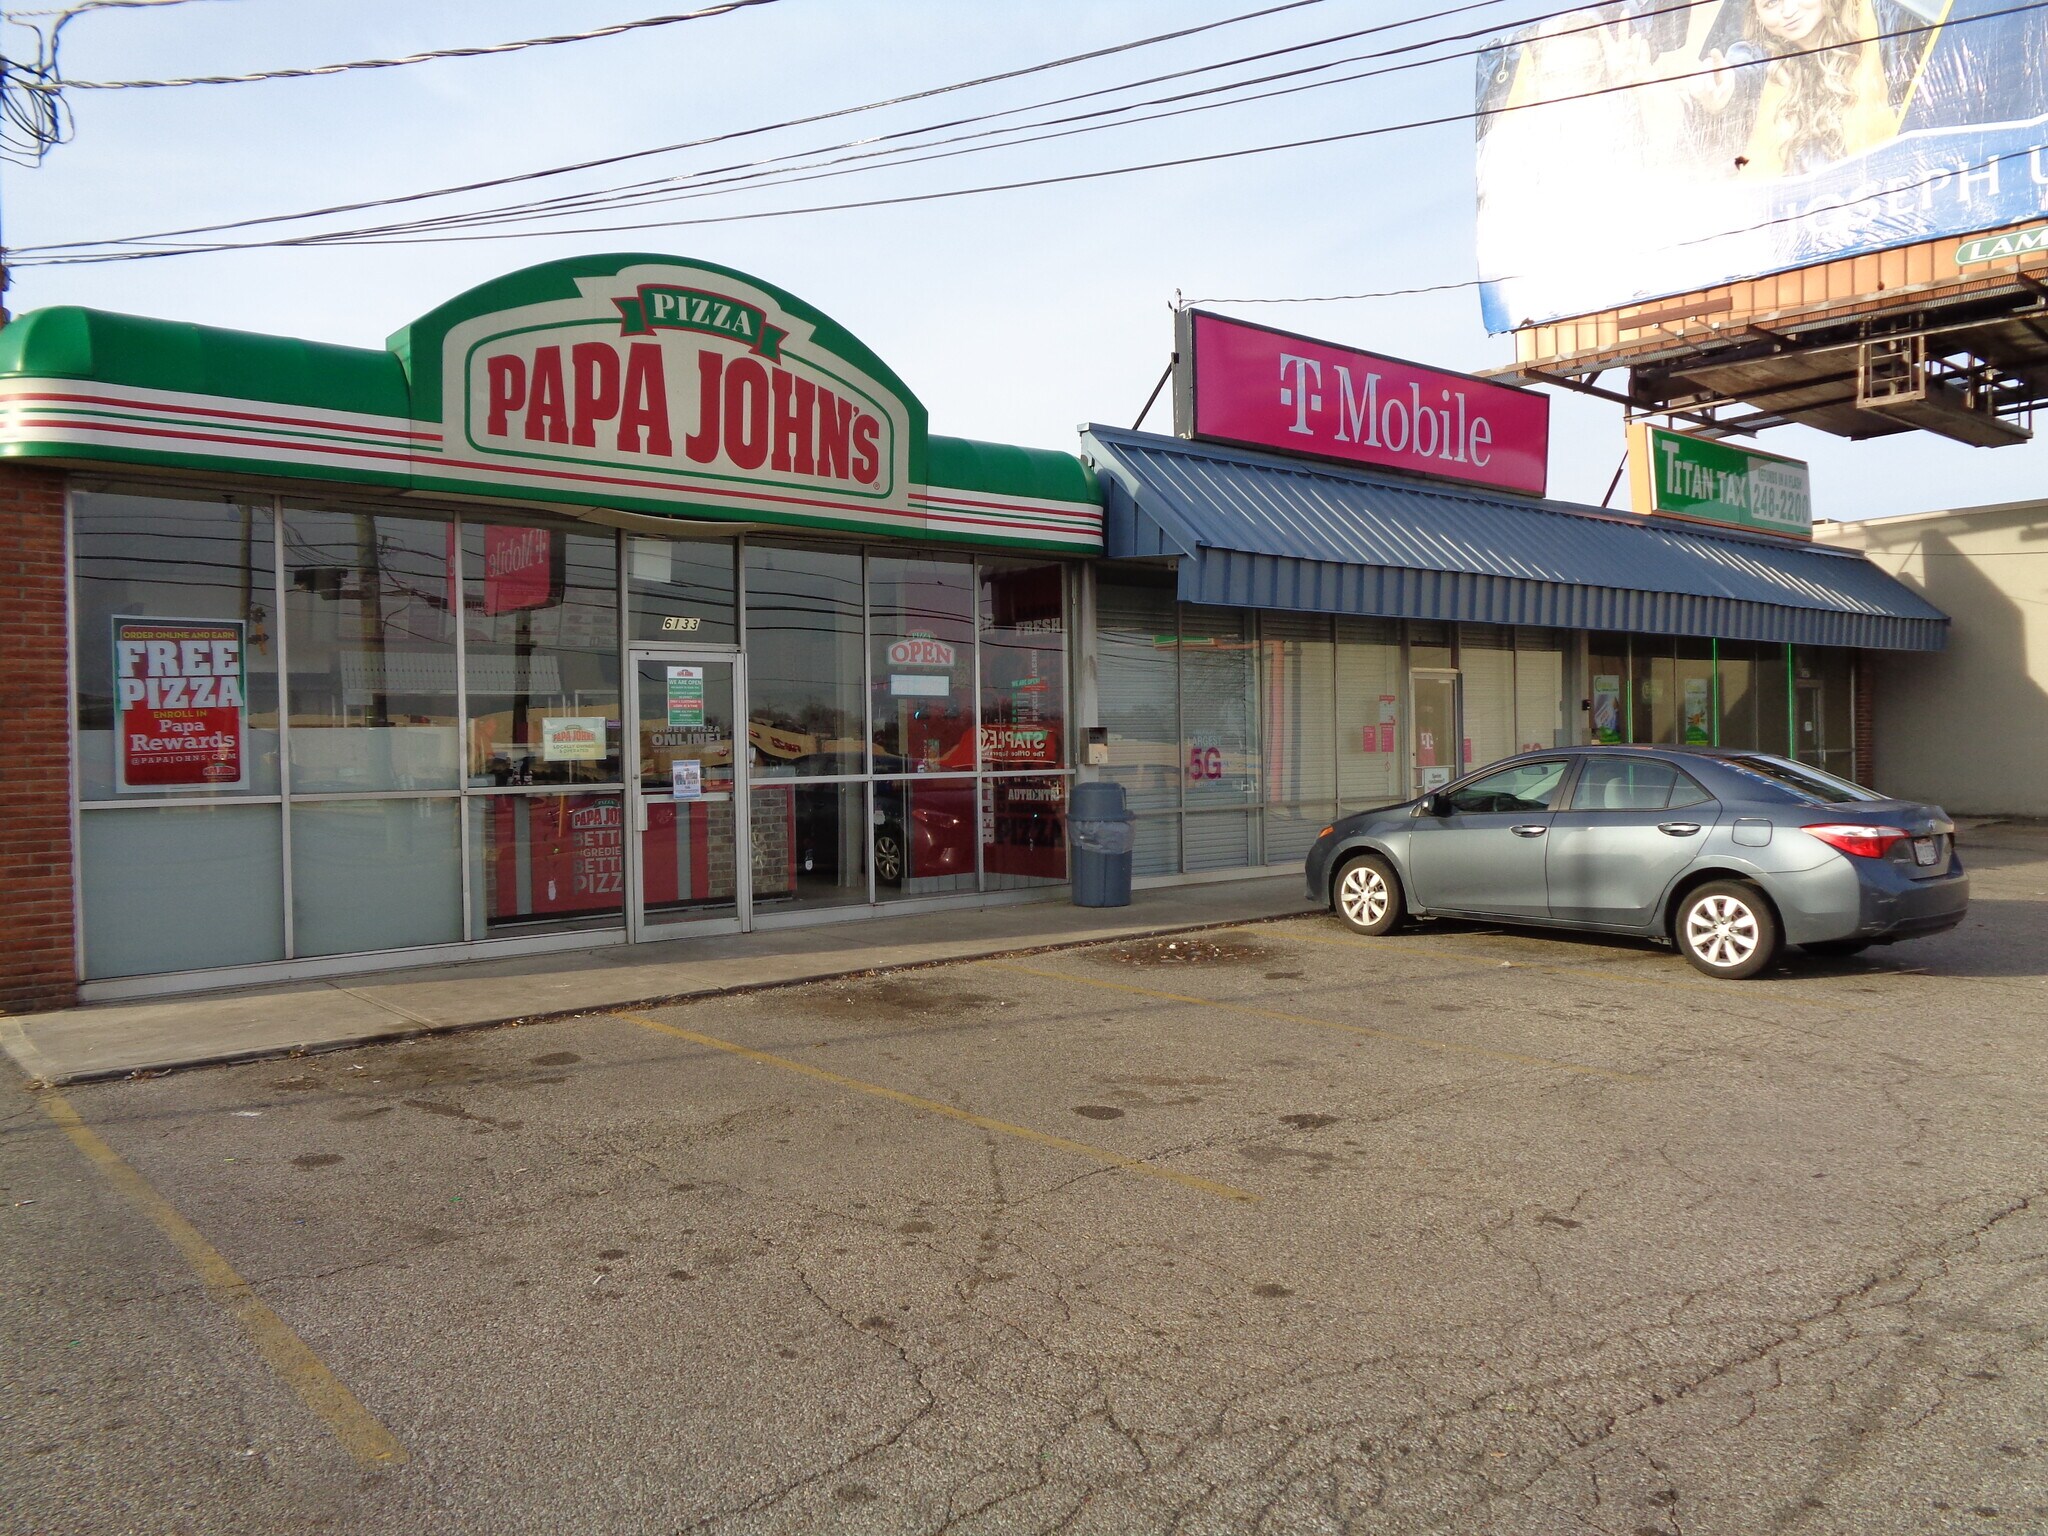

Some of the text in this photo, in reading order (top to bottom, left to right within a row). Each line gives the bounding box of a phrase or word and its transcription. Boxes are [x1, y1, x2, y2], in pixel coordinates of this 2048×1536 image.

[652, 292, 755, 336] PIZZA
[487, 341, 880, 485] PAPA JOHN'S
[1661, 439, 1747, 508] TITAN TAX
[1752, 483, 1809, 524] 248-2200
[664, 618, 698, 630] 6133
[1015, 617, 1061, 637] FRESH
[123, 631, 235, 640] ORDER ONLINE AND EARN
[116, 640, 241, 677] FREE
[891, 641, 952, 665] OPEN
[118, 676, 244, 711] PIZZA
[153, 710, 208, 719] ENROLL IN
[159, 719, 206, 736] Papa
[691, 725, 721, 733] PIZZA
[130, 731, 236, 752] Rewards
[651, 733, 721, 746] ONLINE!
[131, 752, 237, 766] @PAPAJOHNS.COM
[1190, 746, 1222, 780] 5G
[574, 808, 603, 827] PAPA
